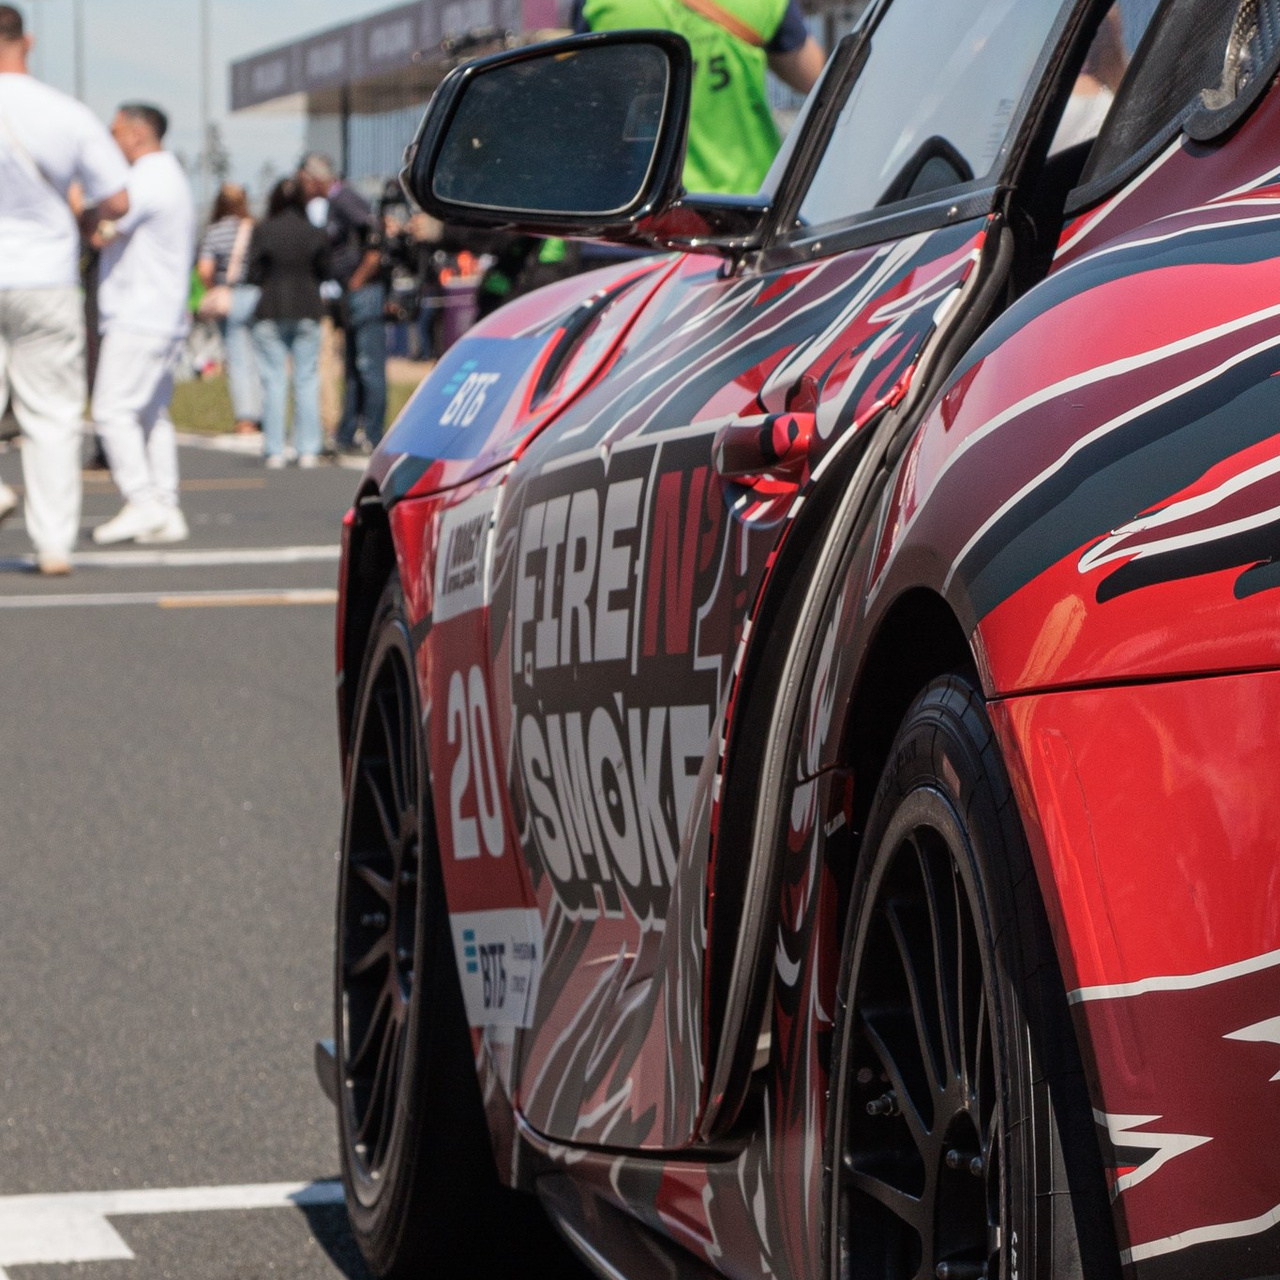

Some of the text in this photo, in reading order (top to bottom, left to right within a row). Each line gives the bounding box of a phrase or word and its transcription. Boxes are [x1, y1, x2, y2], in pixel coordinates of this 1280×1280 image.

[439, 372, 501, 428] ВТБ
[514, 477, 644, 674] FIRE
[447, 664, 505, 861] 20
[520, 704, 711, 888] SMOKE
[479, 942, 507, 1010] ВТБ
